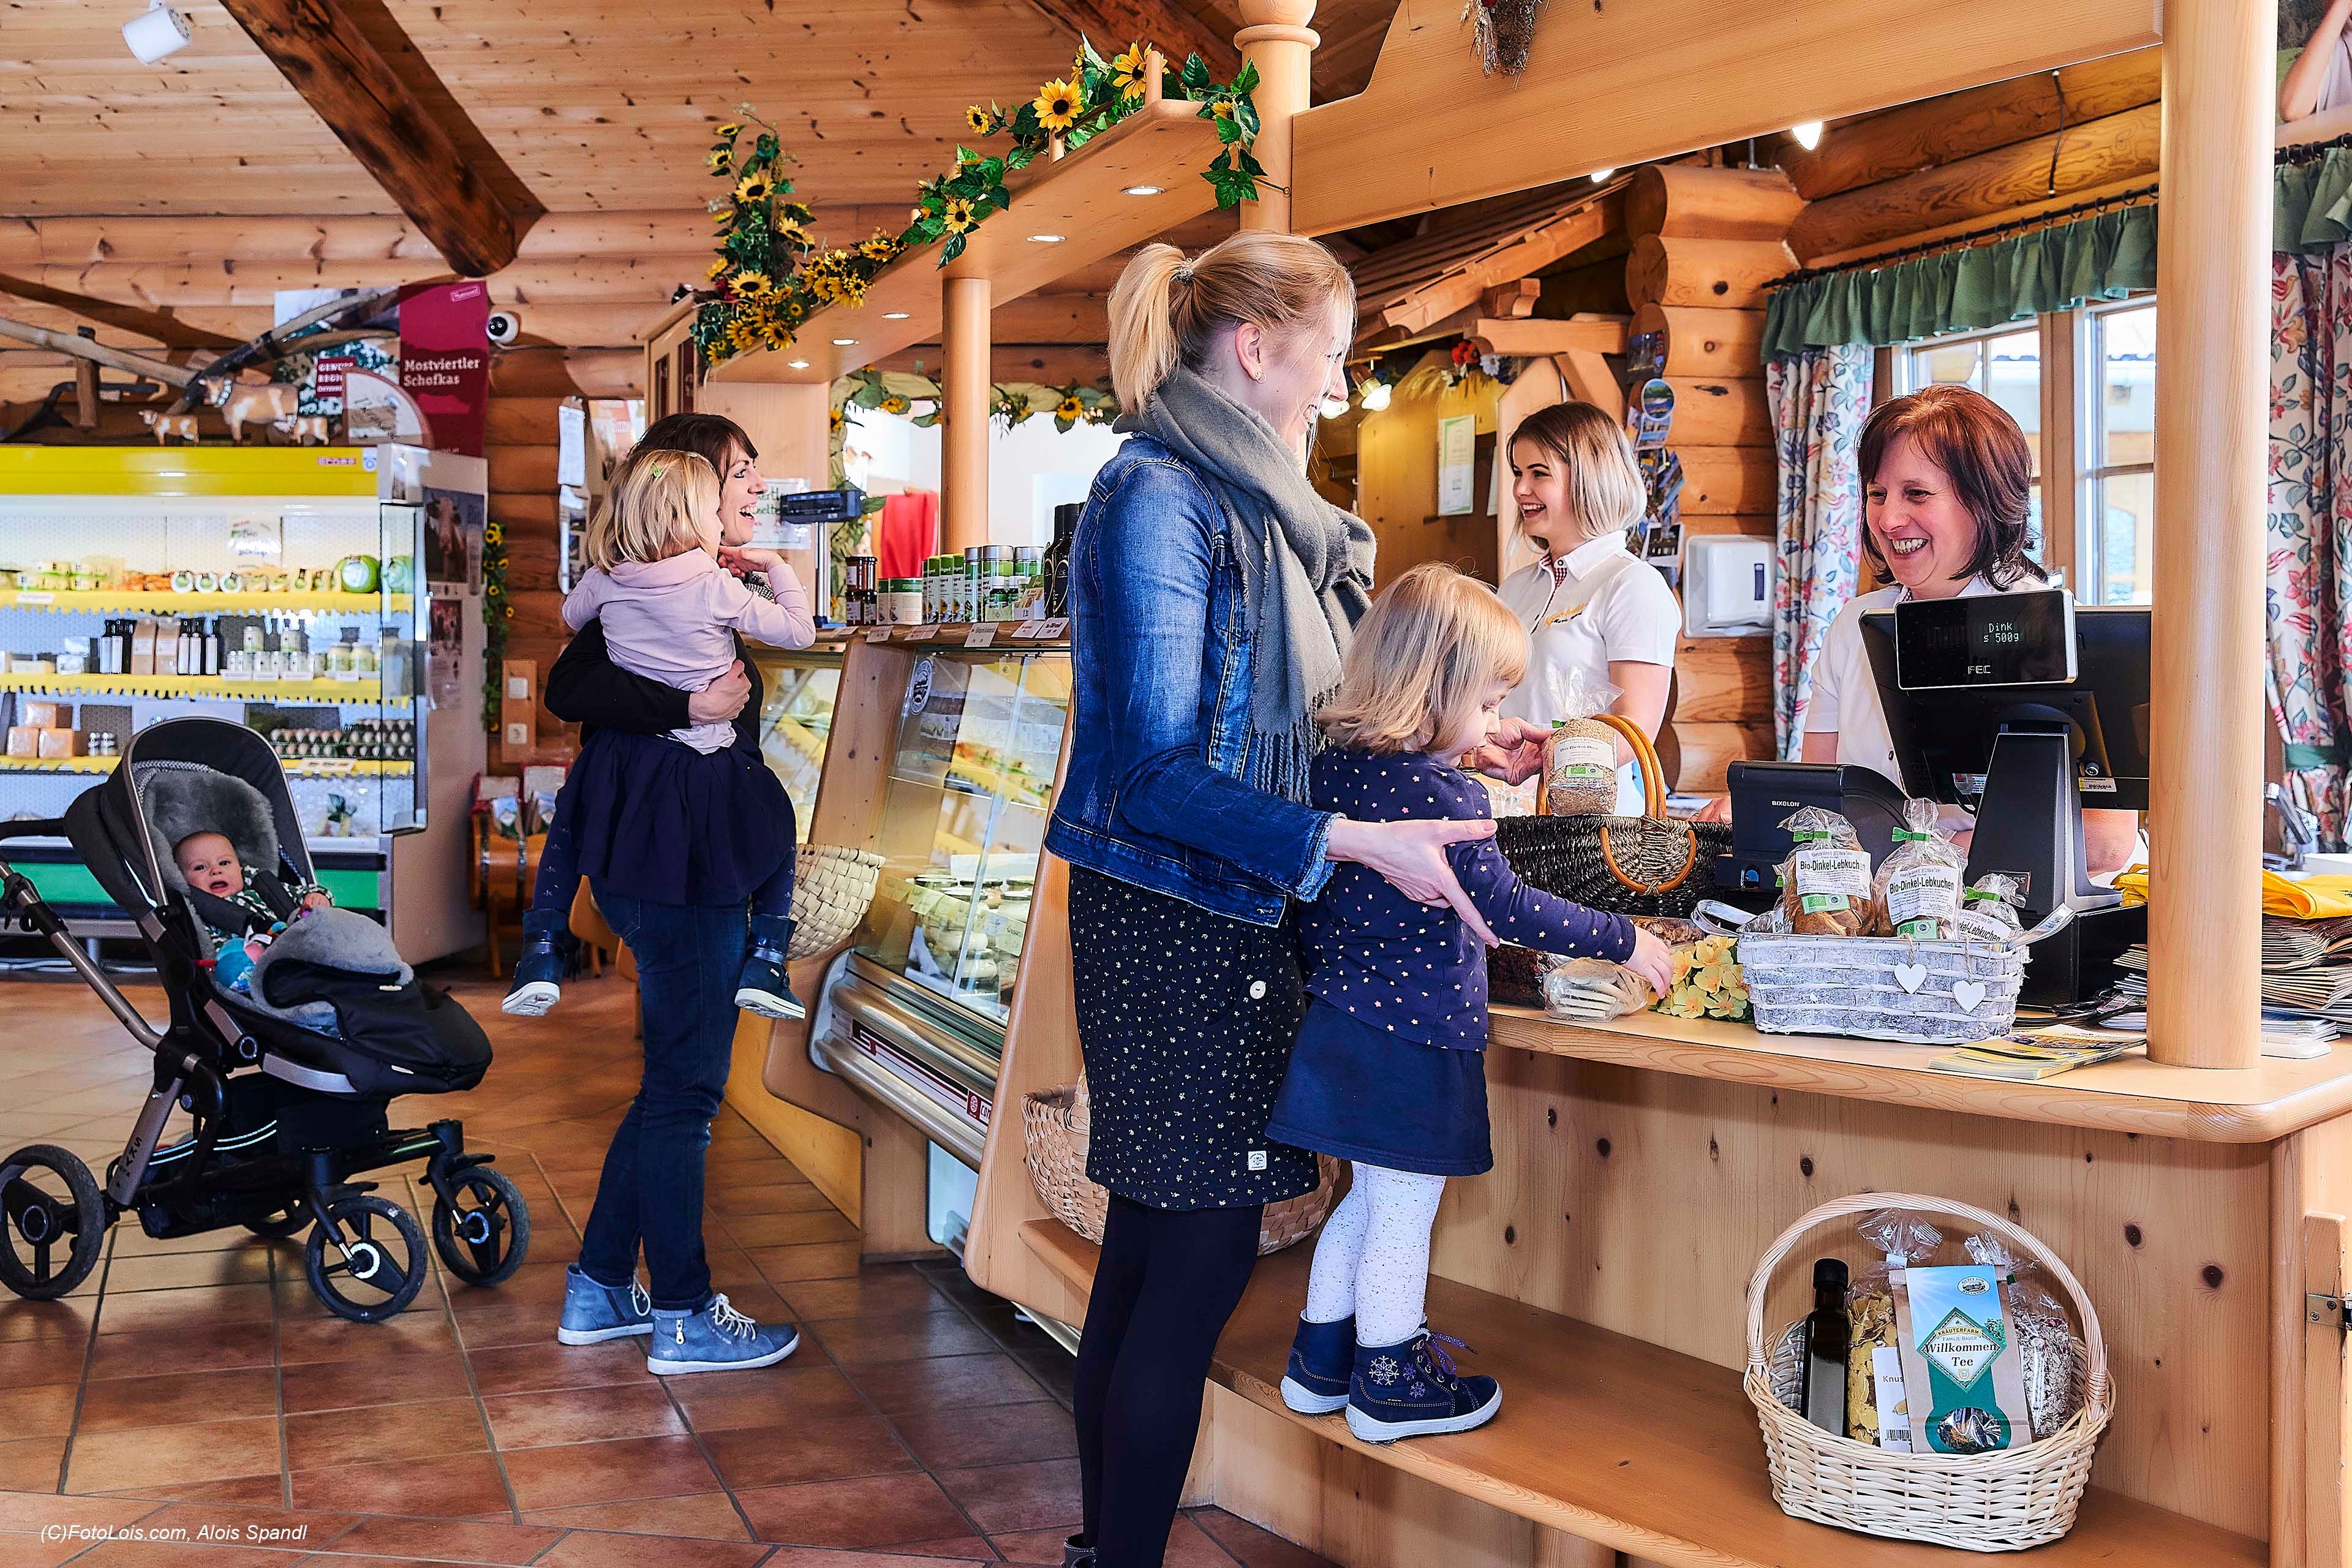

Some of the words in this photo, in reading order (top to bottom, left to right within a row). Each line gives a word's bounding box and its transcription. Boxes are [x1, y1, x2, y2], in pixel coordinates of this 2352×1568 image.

[404, 357, 480, 372] Mostviertler
[404, 374, 460, 387] Schofkas
[1989, 622, 2013, 633] Dink
[1995, 632, 2019, 643] 500g
[1967, 665, 1991, 674] FEC
[1800, 859, 1866, 872] Bio-Dinkel-Lebkuchen
[1890, 876, 1954, 894] Bio-Dinkel-Lebkuchen
[1938, 1327, 1980, 1336] KRÄUTERFARM
[1925, 1343, 1997, 1354] Willkommen
[1951, 1357, 1973, 1366] Tee
